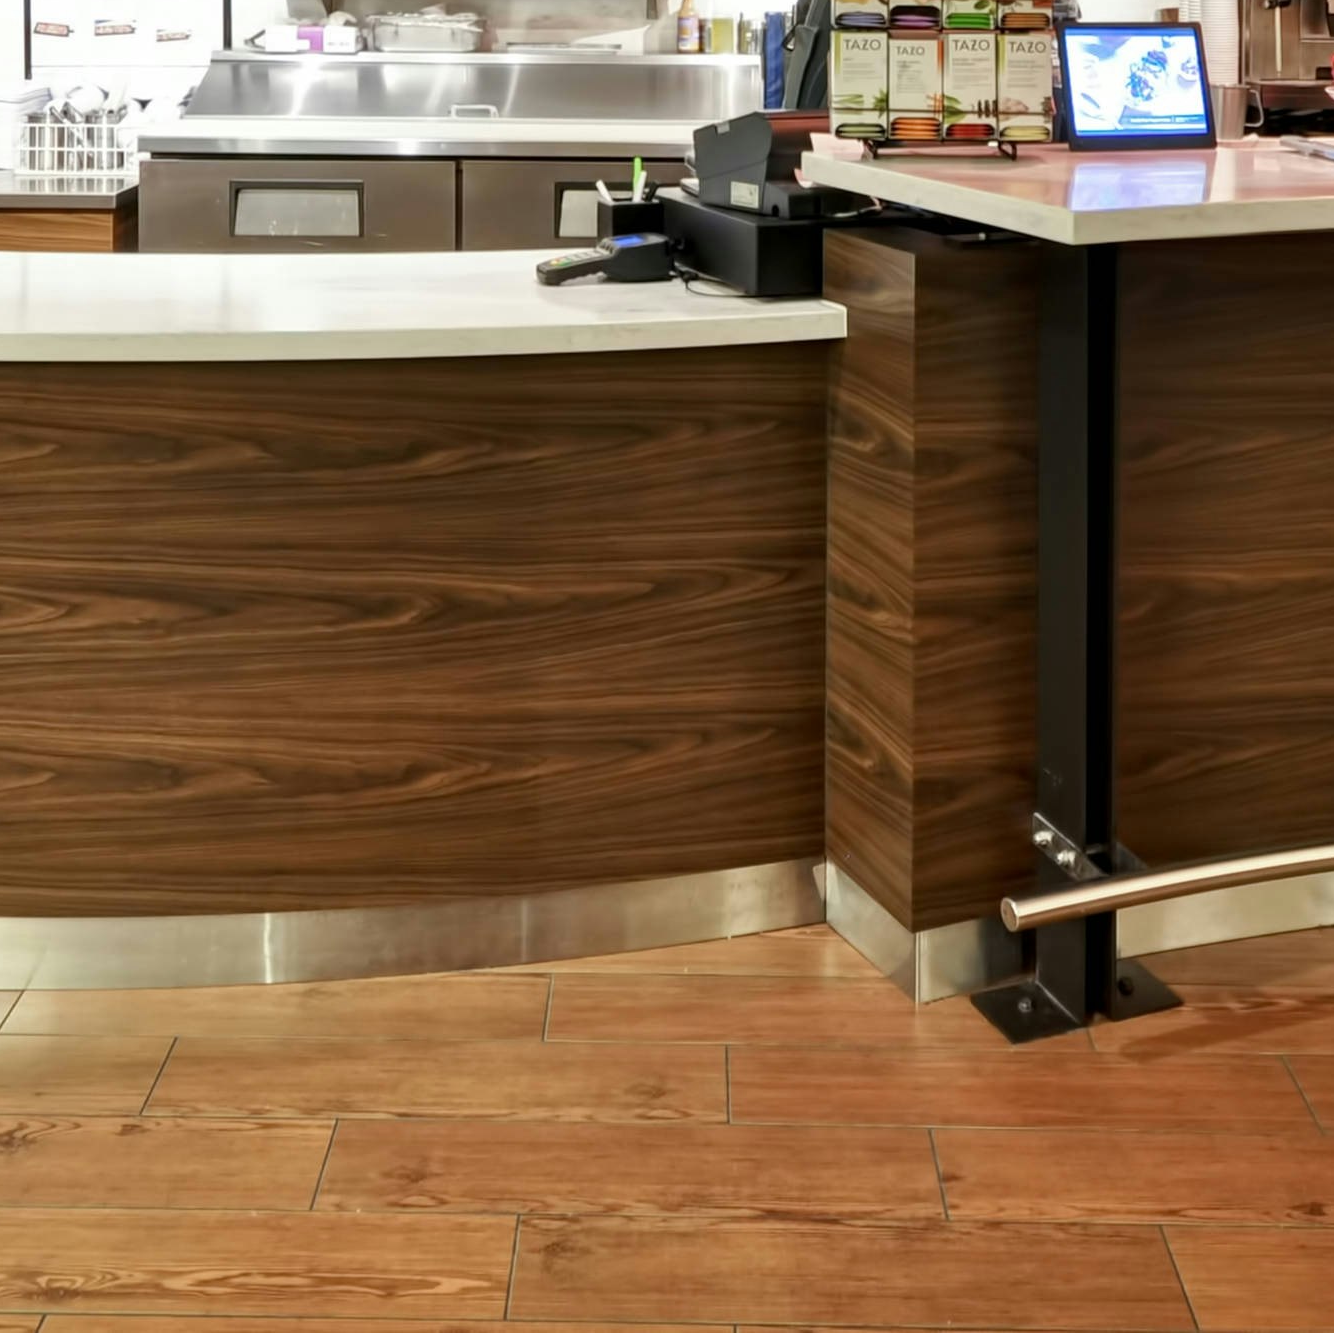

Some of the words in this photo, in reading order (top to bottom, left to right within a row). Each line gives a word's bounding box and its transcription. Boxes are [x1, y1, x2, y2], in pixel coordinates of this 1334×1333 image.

[843, 39, 882, 51] TAZO
[896, 46, 925, 56] TAZO
[953, 39, 991, 52] TAZO
[1009, 41, 1047, 54] TAZO
